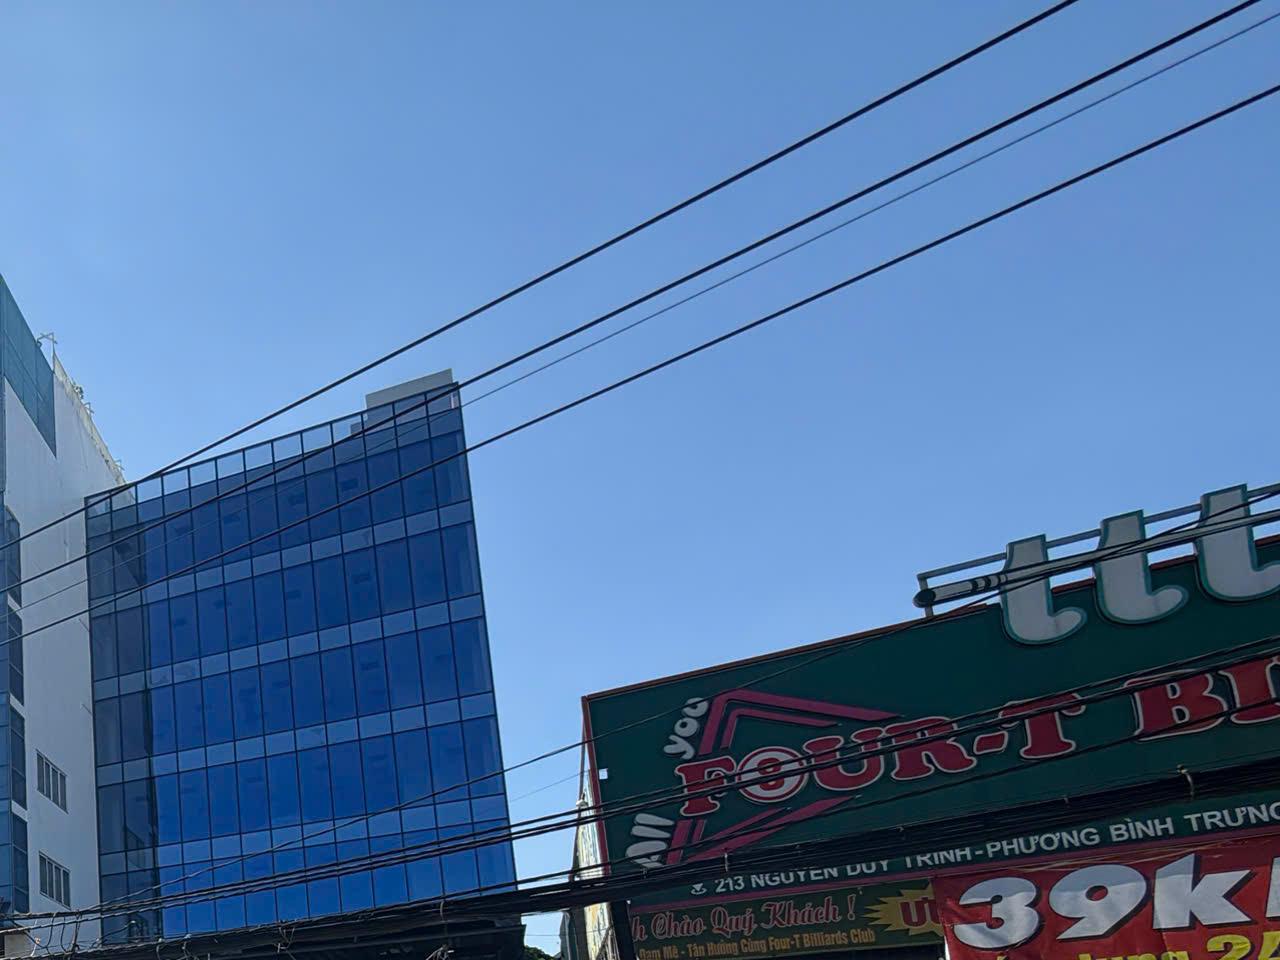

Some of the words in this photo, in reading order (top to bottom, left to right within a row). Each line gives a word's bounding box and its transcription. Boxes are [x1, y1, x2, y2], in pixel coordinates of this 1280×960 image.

[714, 876, 745, 894] 213
[1109, 817, 1174, 842] BÌNH
[651, 911, 706, 940] Chào
[761, 895, 841, 928] Khách
[803, 931, 848, 948] Billiards
[850, 928, 877, 944] Club
